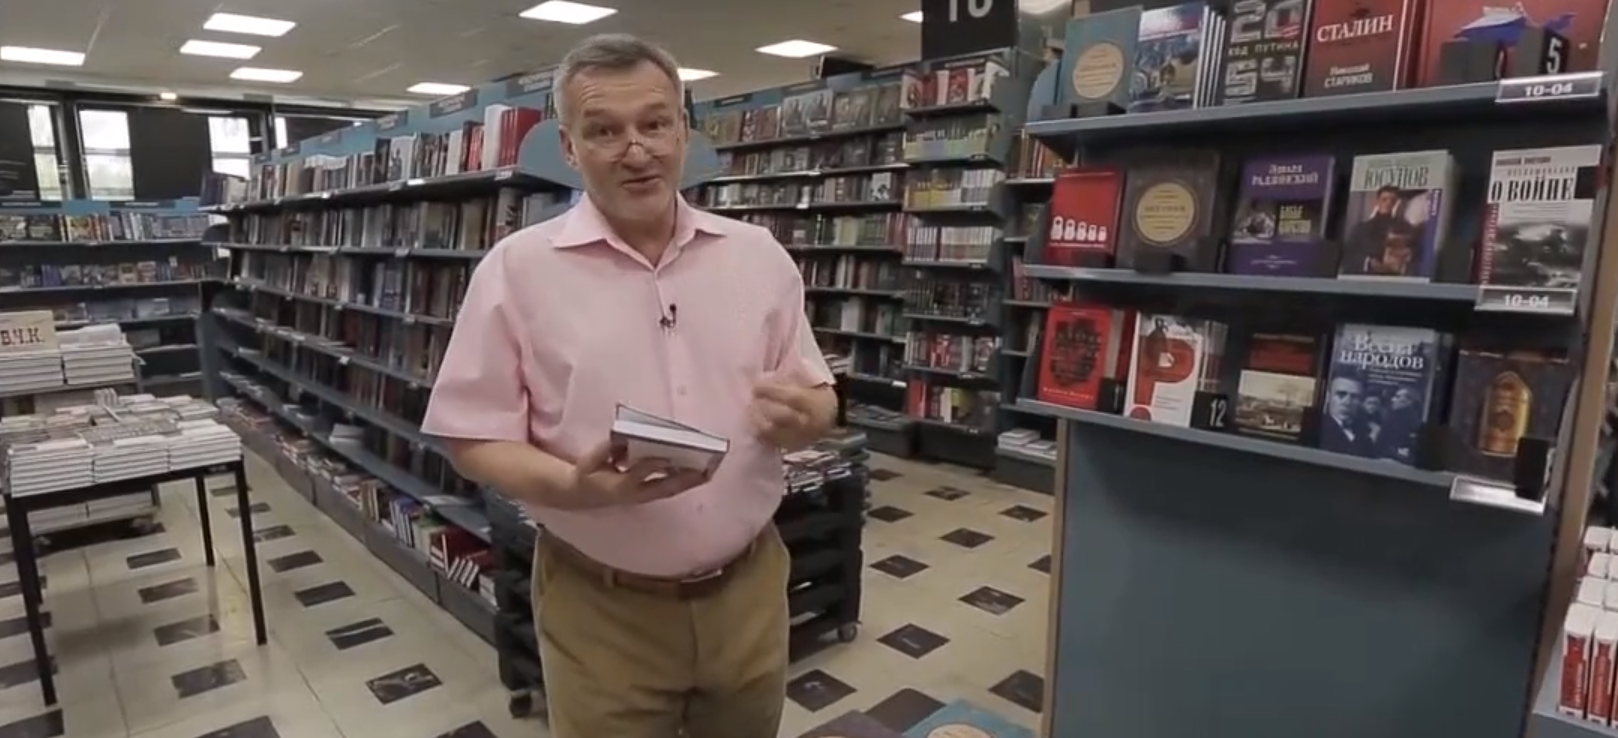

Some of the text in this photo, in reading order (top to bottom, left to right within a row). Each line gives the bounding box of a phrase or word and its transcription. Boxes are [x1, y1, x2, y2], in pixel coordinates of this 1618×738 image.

[1317, 14, 1394, 42] СТАЛИН
[1255, 42, 1299, 55] ПУТИНА
[1546, 37, 1563, 74] 5
[1324, 72, 1373, 89] СТАРИКОВ
[1524, 83, 1574, 97] 10-04
[1490, 175, 1574, 202] О ВОЙНЕ
[1503, 294, 1550, 308] 10-04
[1354, 333, 1413, 355] Весна
[1340, 350, 1424, 371] народов
[1209, 399, 1227, 428] 12
